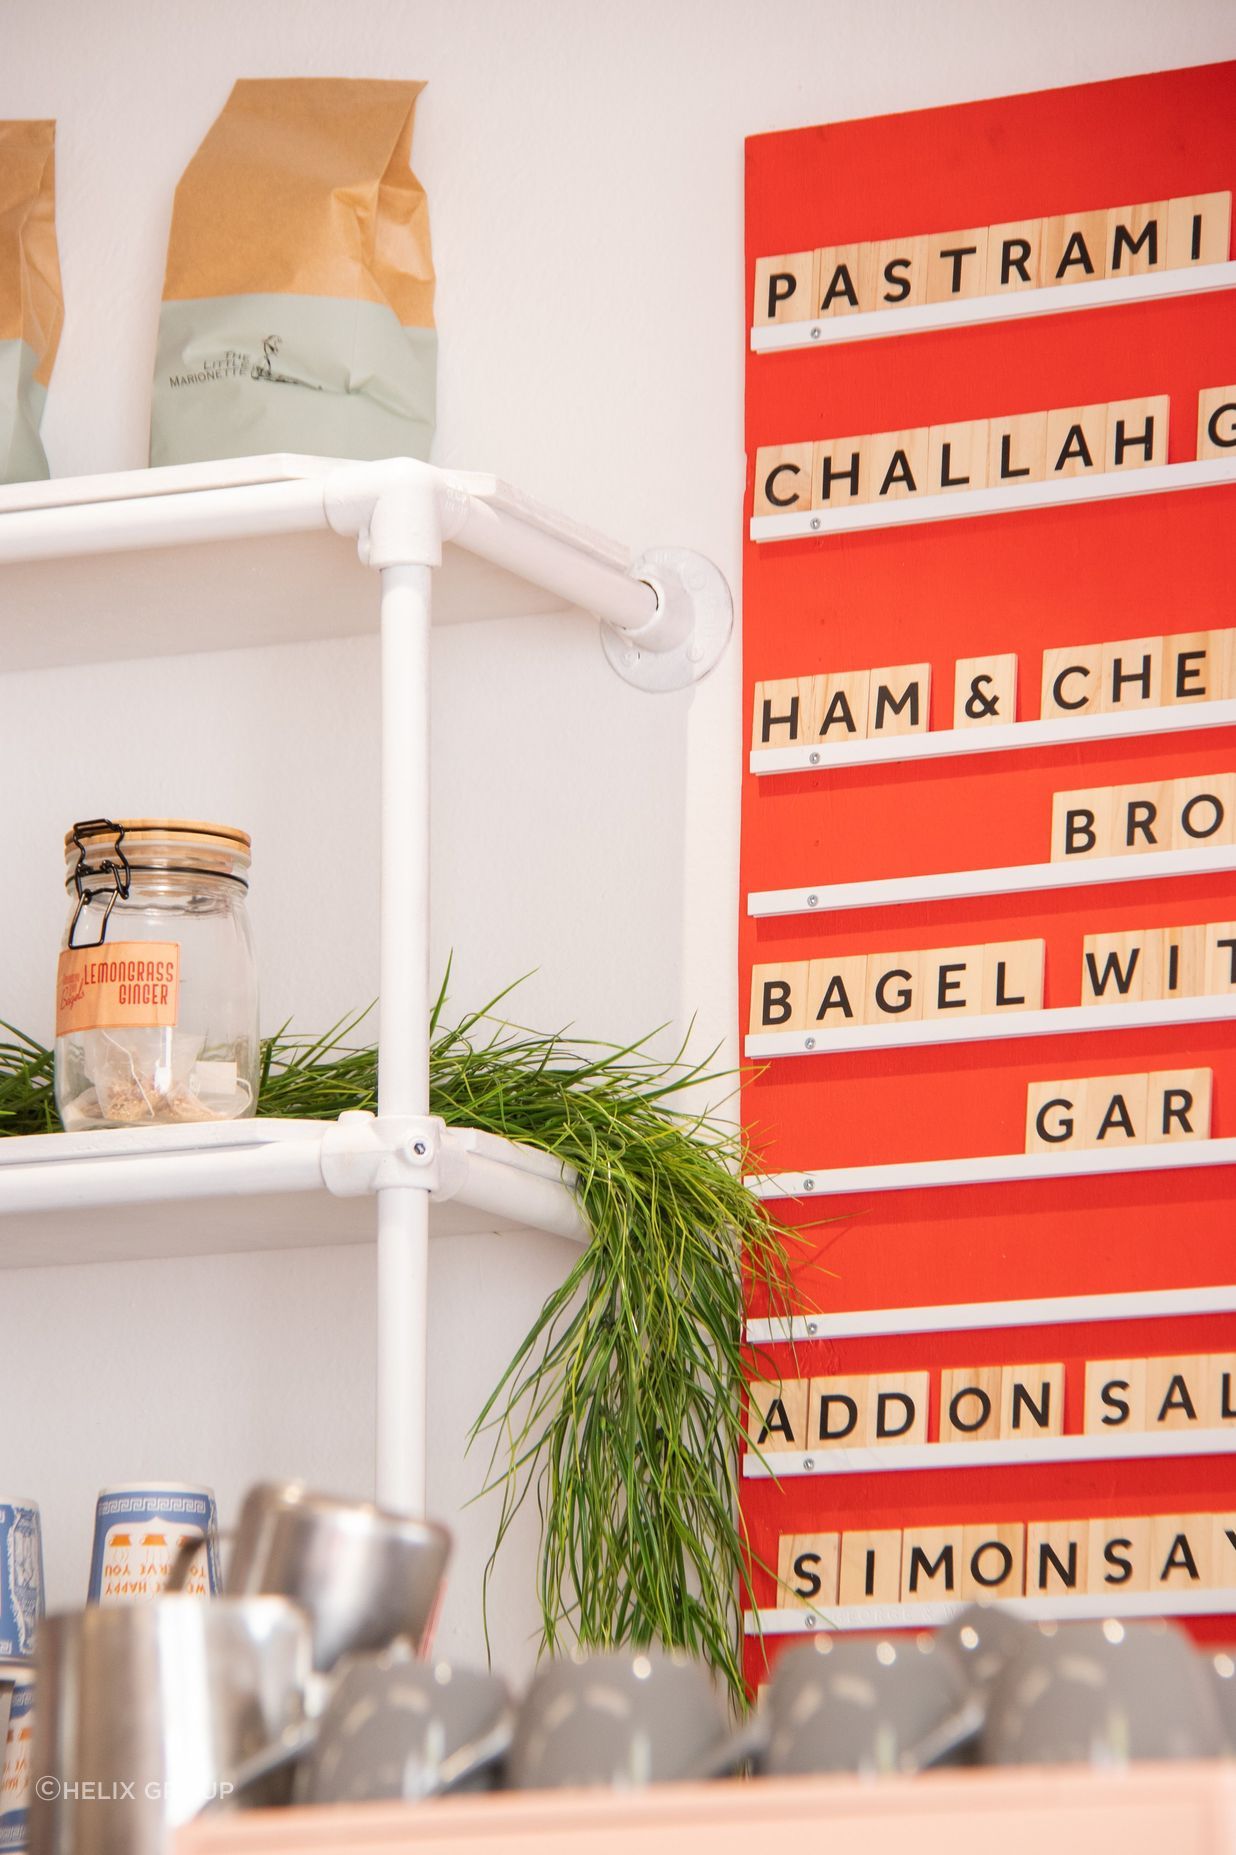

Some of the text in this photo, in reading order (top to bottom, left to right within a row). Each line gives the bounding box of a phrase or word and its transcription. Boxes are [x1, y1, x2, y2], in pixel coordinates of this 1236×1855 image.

[767, 215, 1202, 318] PASTRAMI
[169, 366, 249, 388] MARIONETTE
[204, 357, 249, 370] LITTLE
[765, 416, 1154, 507] CHALLAH
[761, 651, 1206, 743] HAM & CHE
[1065, 794, 1223, 855] BRO
[84, 961, 174, 985] LEMONGRASS
[119, 983, 168, 1005] GINGER
[762, 962, 1025, 1026] BAGEL
[1036, 1089, 1193, 1141] GAR
[757, 1392, 915, 1445] ADD
[949, 1382, 1050, 1432] ON
[793, 1530, 1236, 1599] SIMONSA
